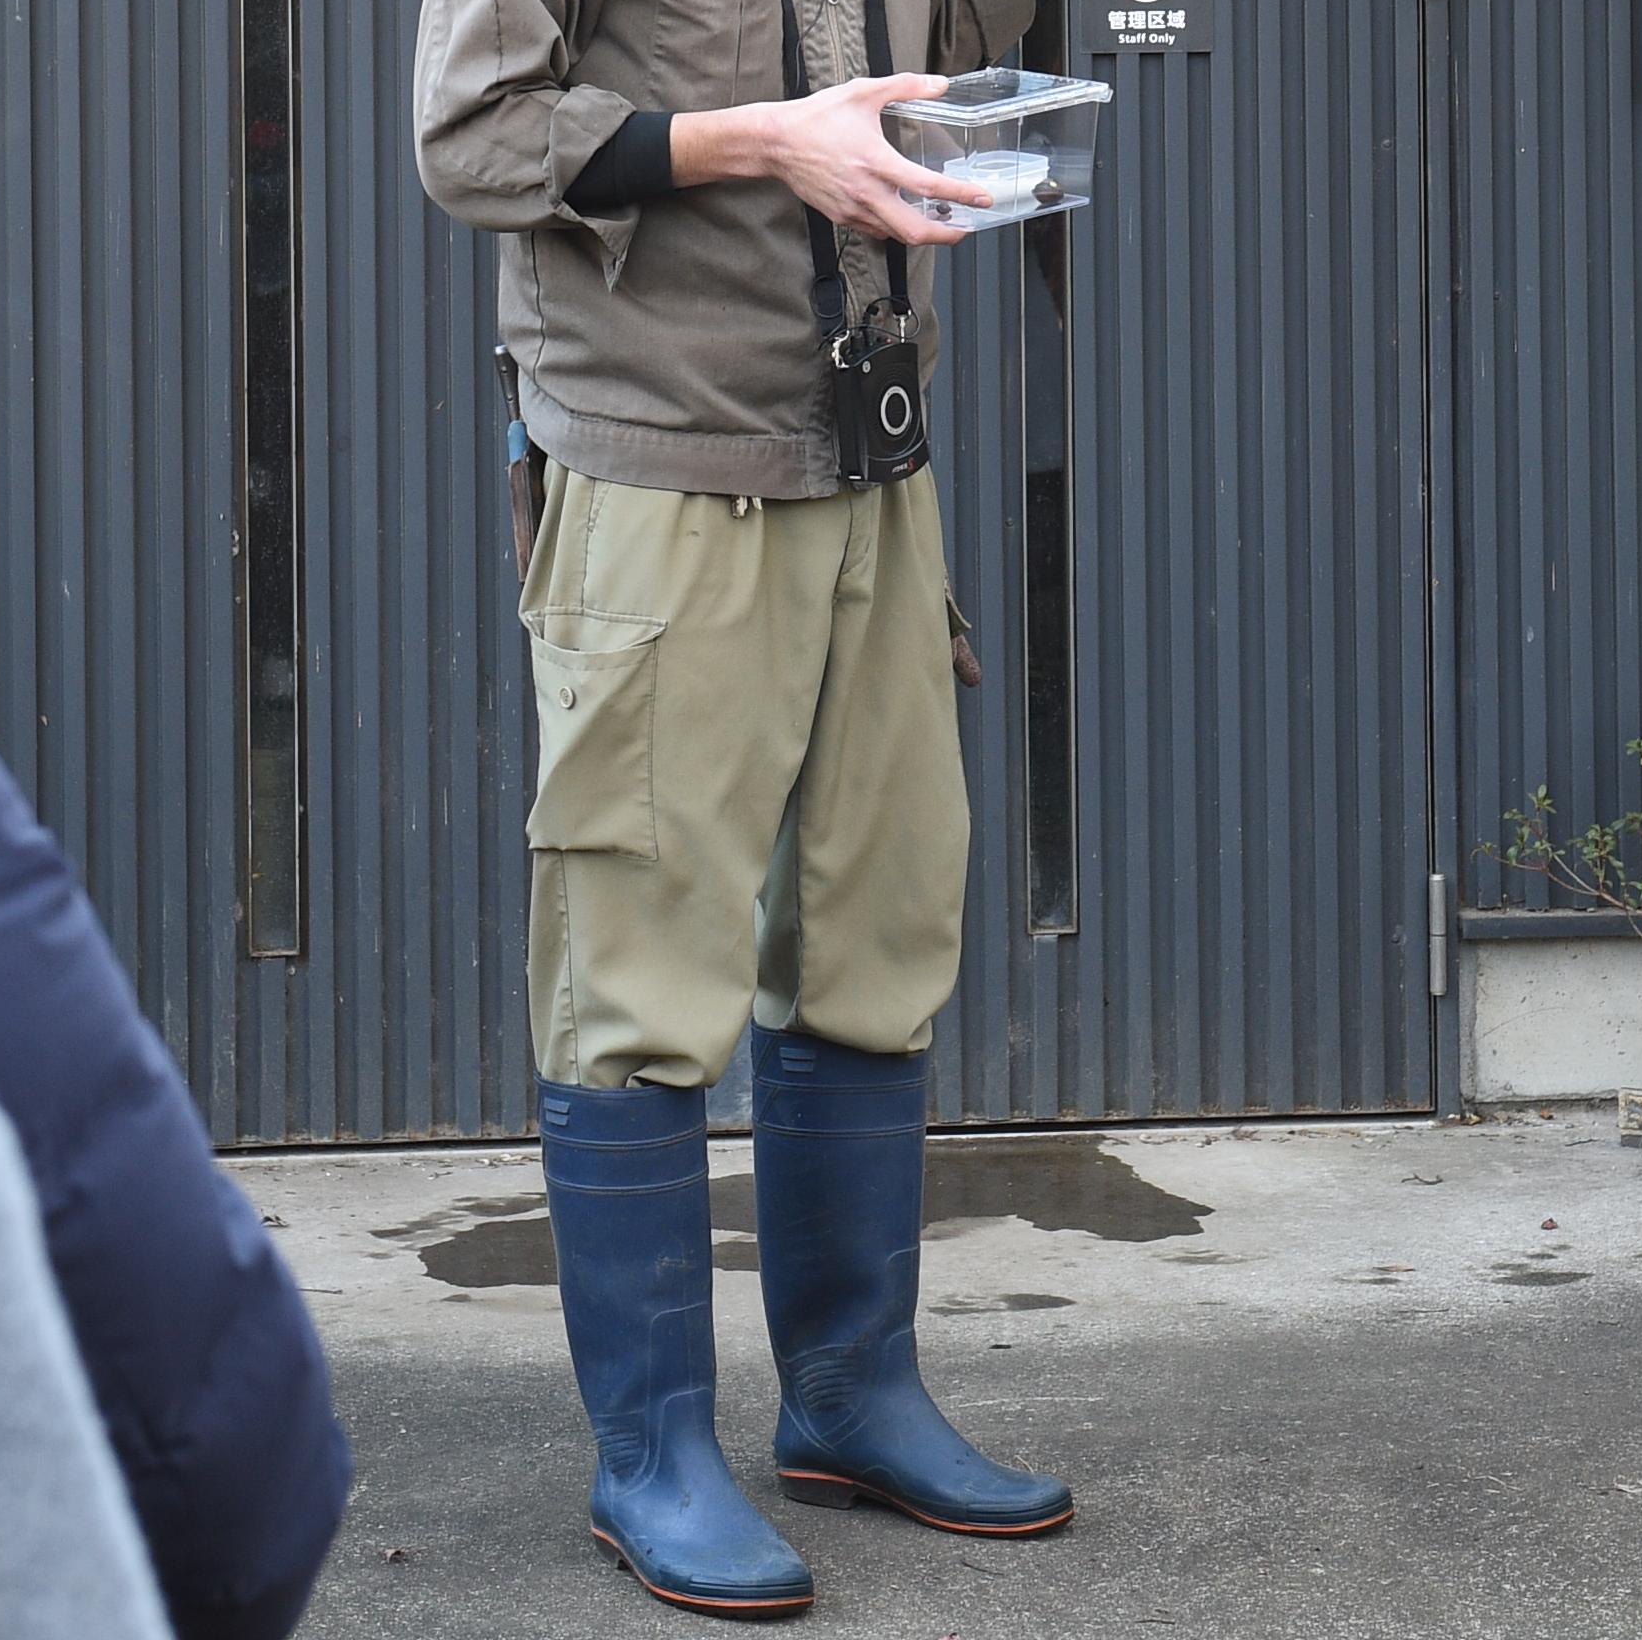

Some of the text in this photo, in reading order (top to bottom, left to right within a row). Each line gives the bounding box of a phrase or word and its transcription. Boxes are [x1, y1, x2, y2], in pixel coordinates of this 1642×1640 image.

[1108, 9, 1186, 30] 管理区域
[1118, 32, 1176, 46] Staff Only
